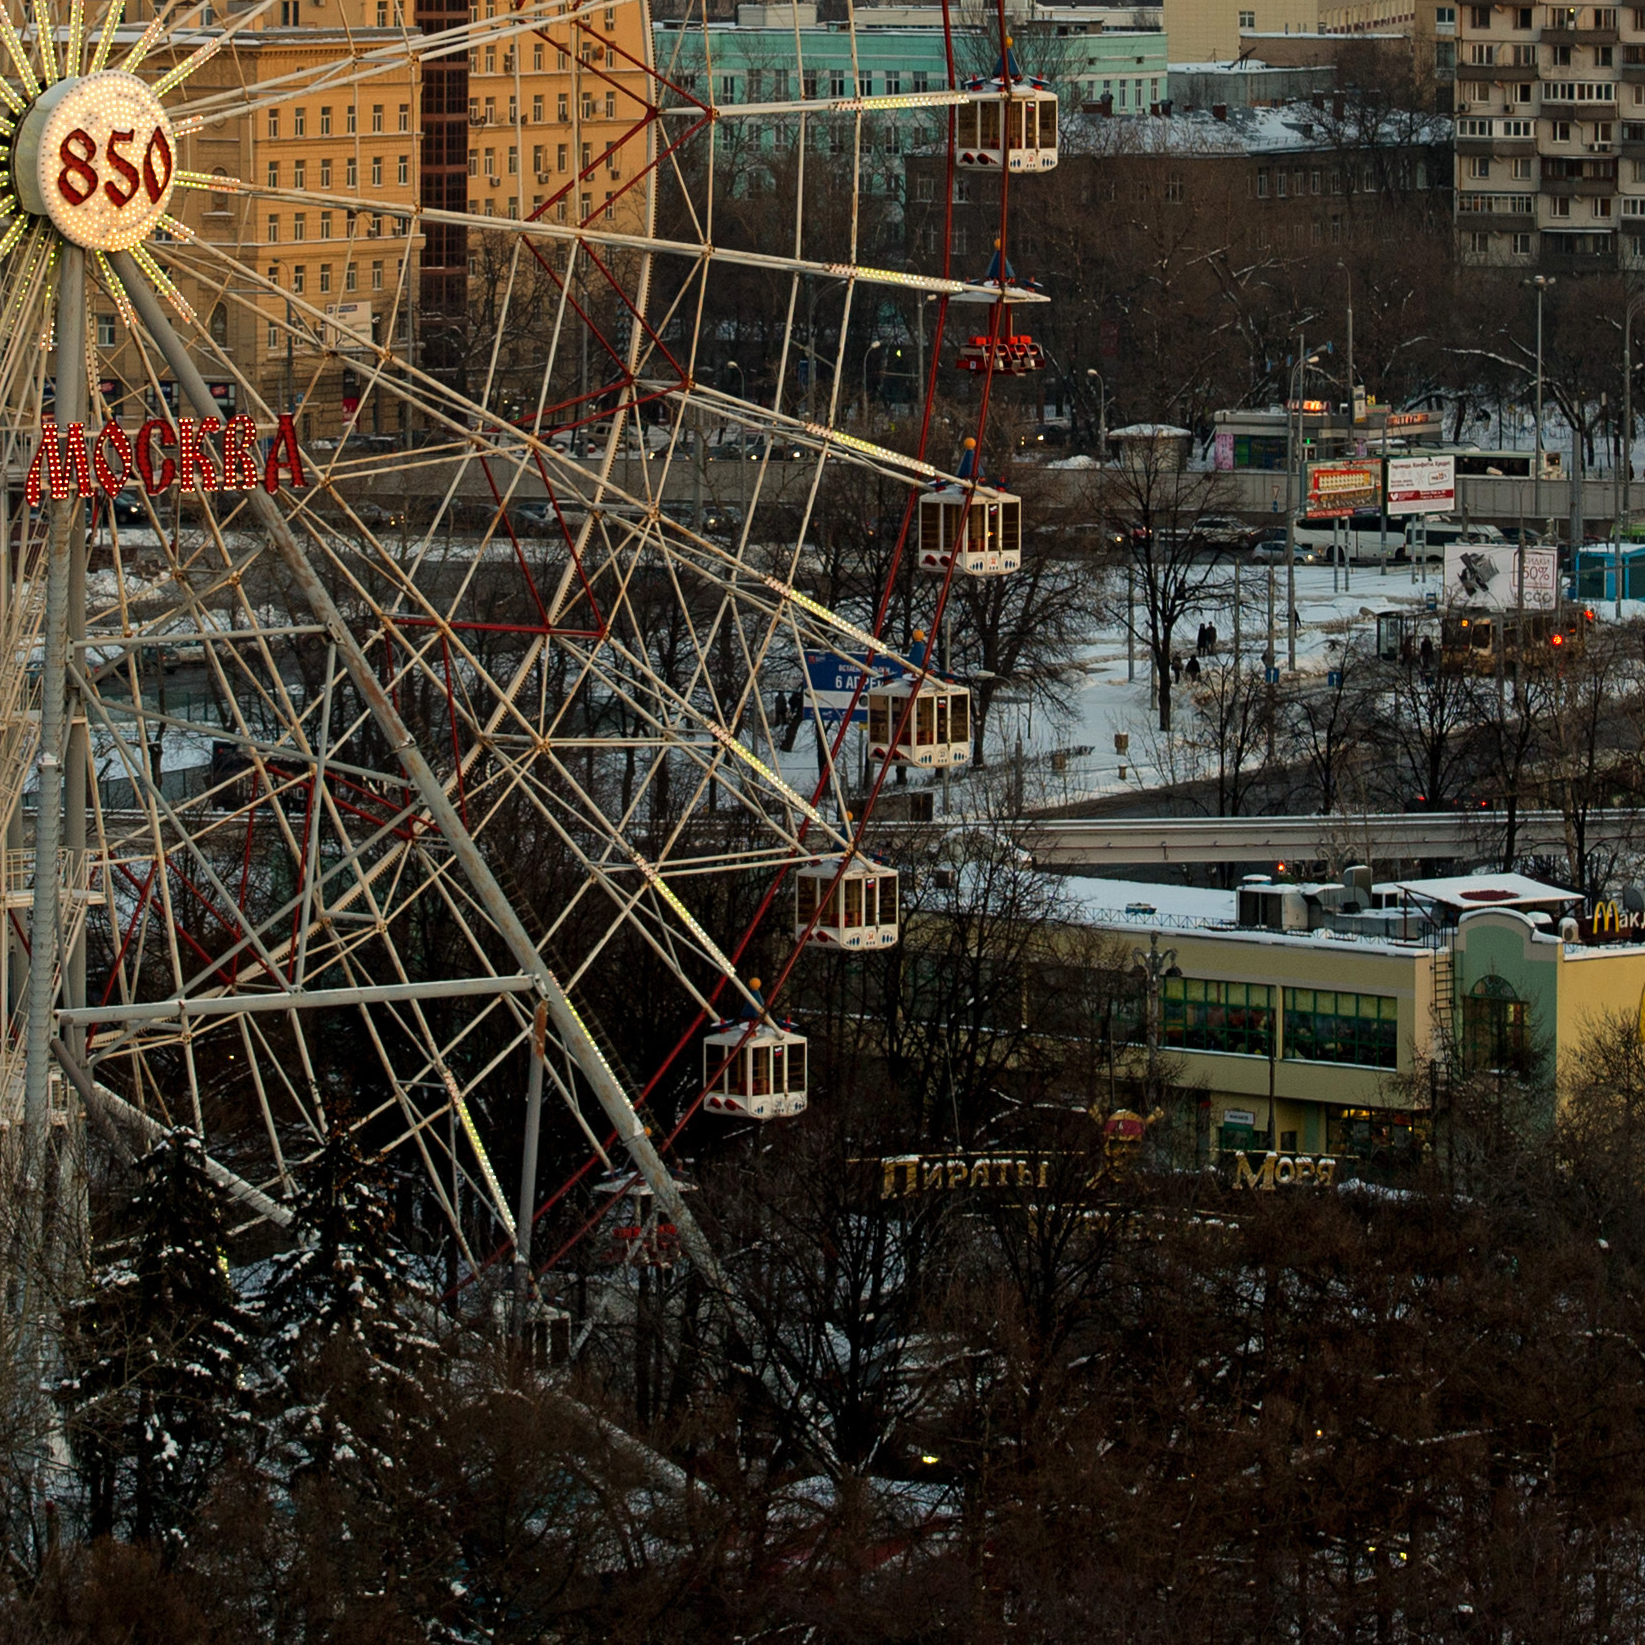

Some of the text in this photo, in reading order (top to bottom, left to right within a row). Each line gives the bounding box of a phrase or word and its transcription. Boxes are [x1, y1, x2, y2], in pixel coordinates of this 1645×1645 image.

[58, 126, 172, 207] 850
[25, 412, 308, 506] МОСКВА
[1522, 557, 1550, 565] КИДКИ
[1522, 567, 1550, 580] 50%
[1517, 591, 1553, 603] CCO
[835, 675, 843, 689] 6
